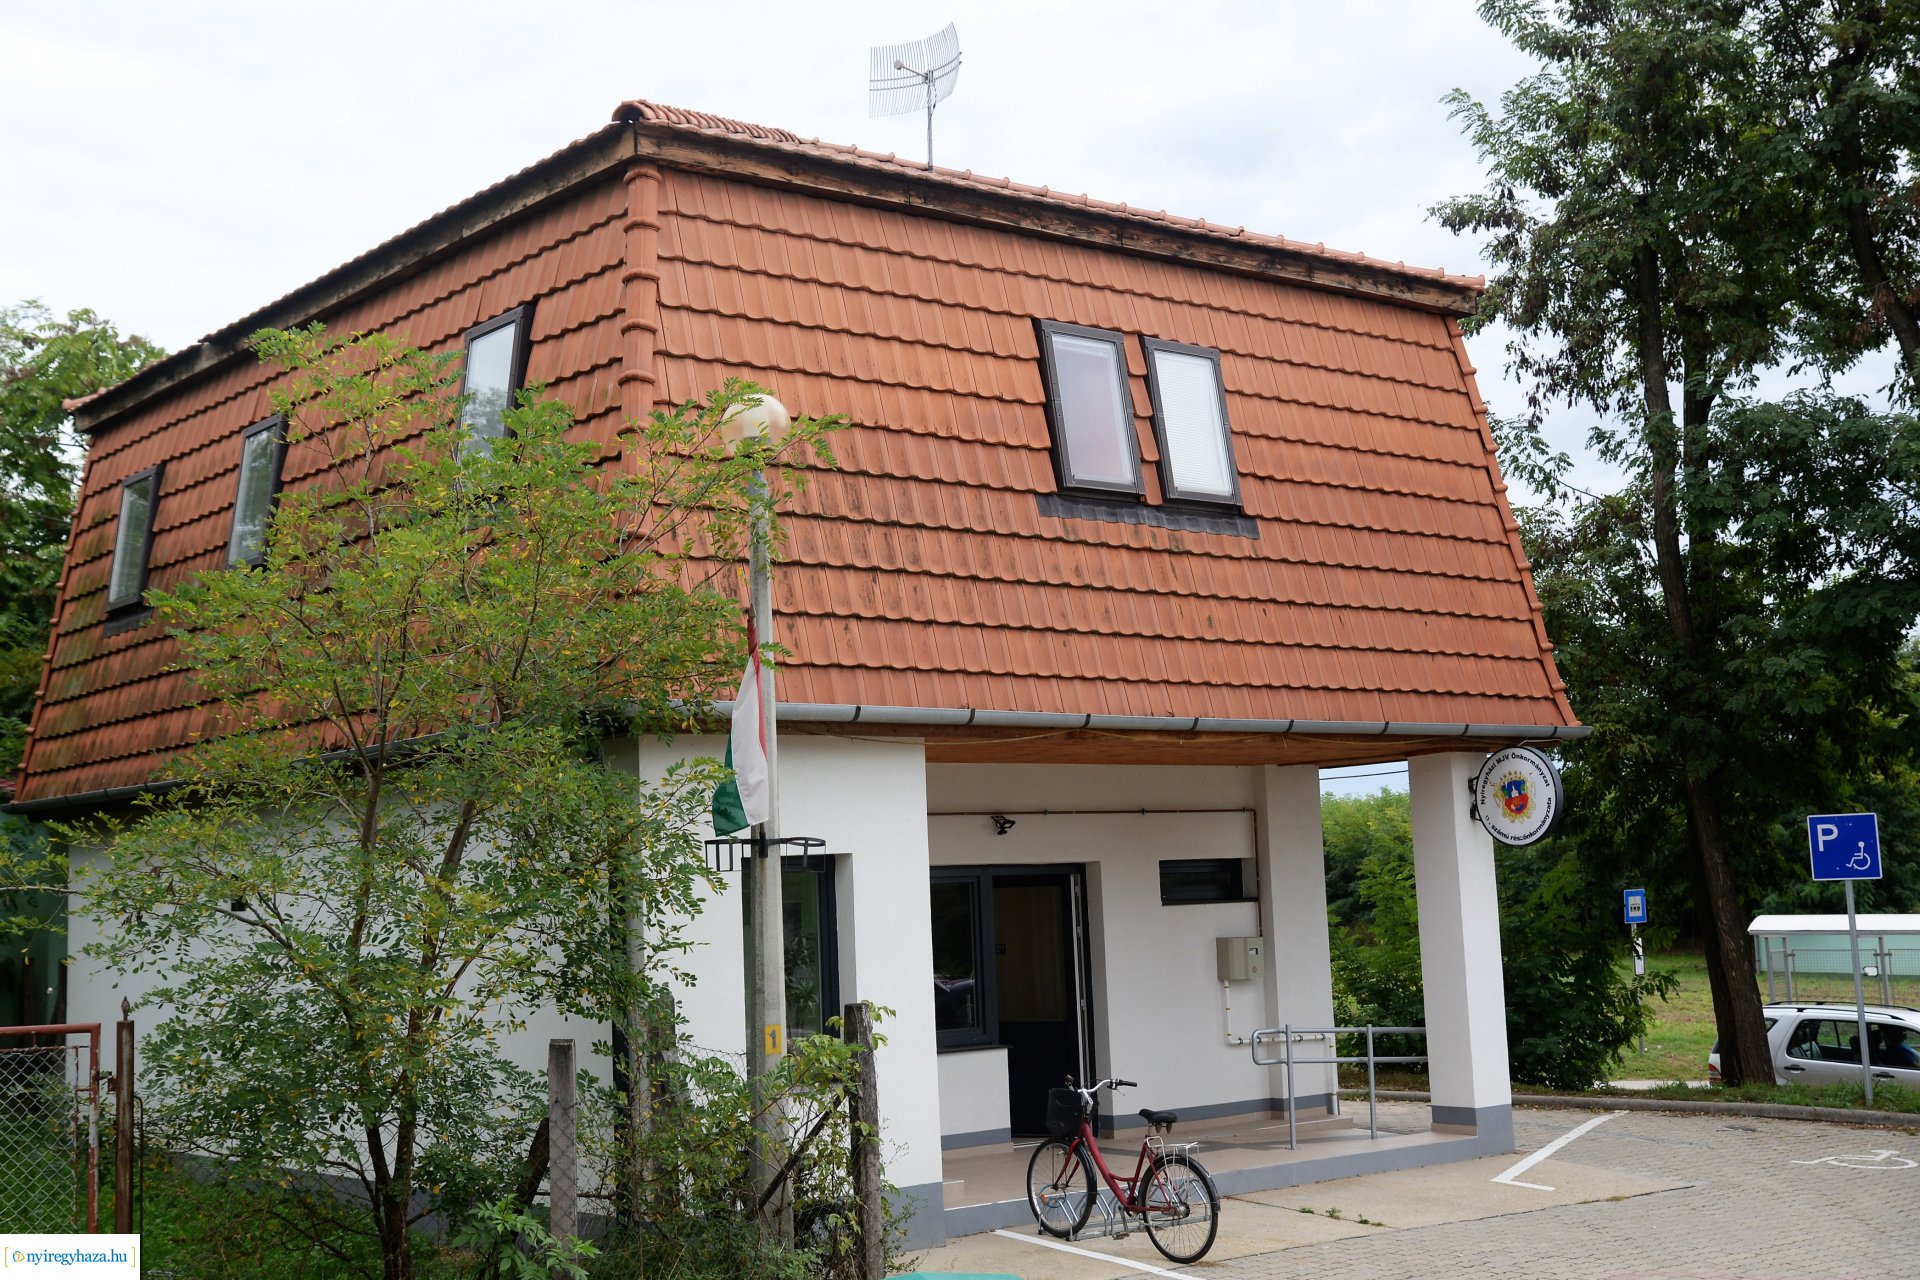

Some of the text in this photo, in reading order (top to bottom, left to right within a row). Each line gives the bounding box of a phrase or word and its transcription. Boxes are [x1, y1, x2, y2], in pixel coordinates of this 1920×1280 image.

[1496, 754, 1510, 764] MJV
[1511, 752, 1551, 787] Önkormányzat
[1817, 824, 1838, 851] P
[768, 1030, 776, 1048] 1
